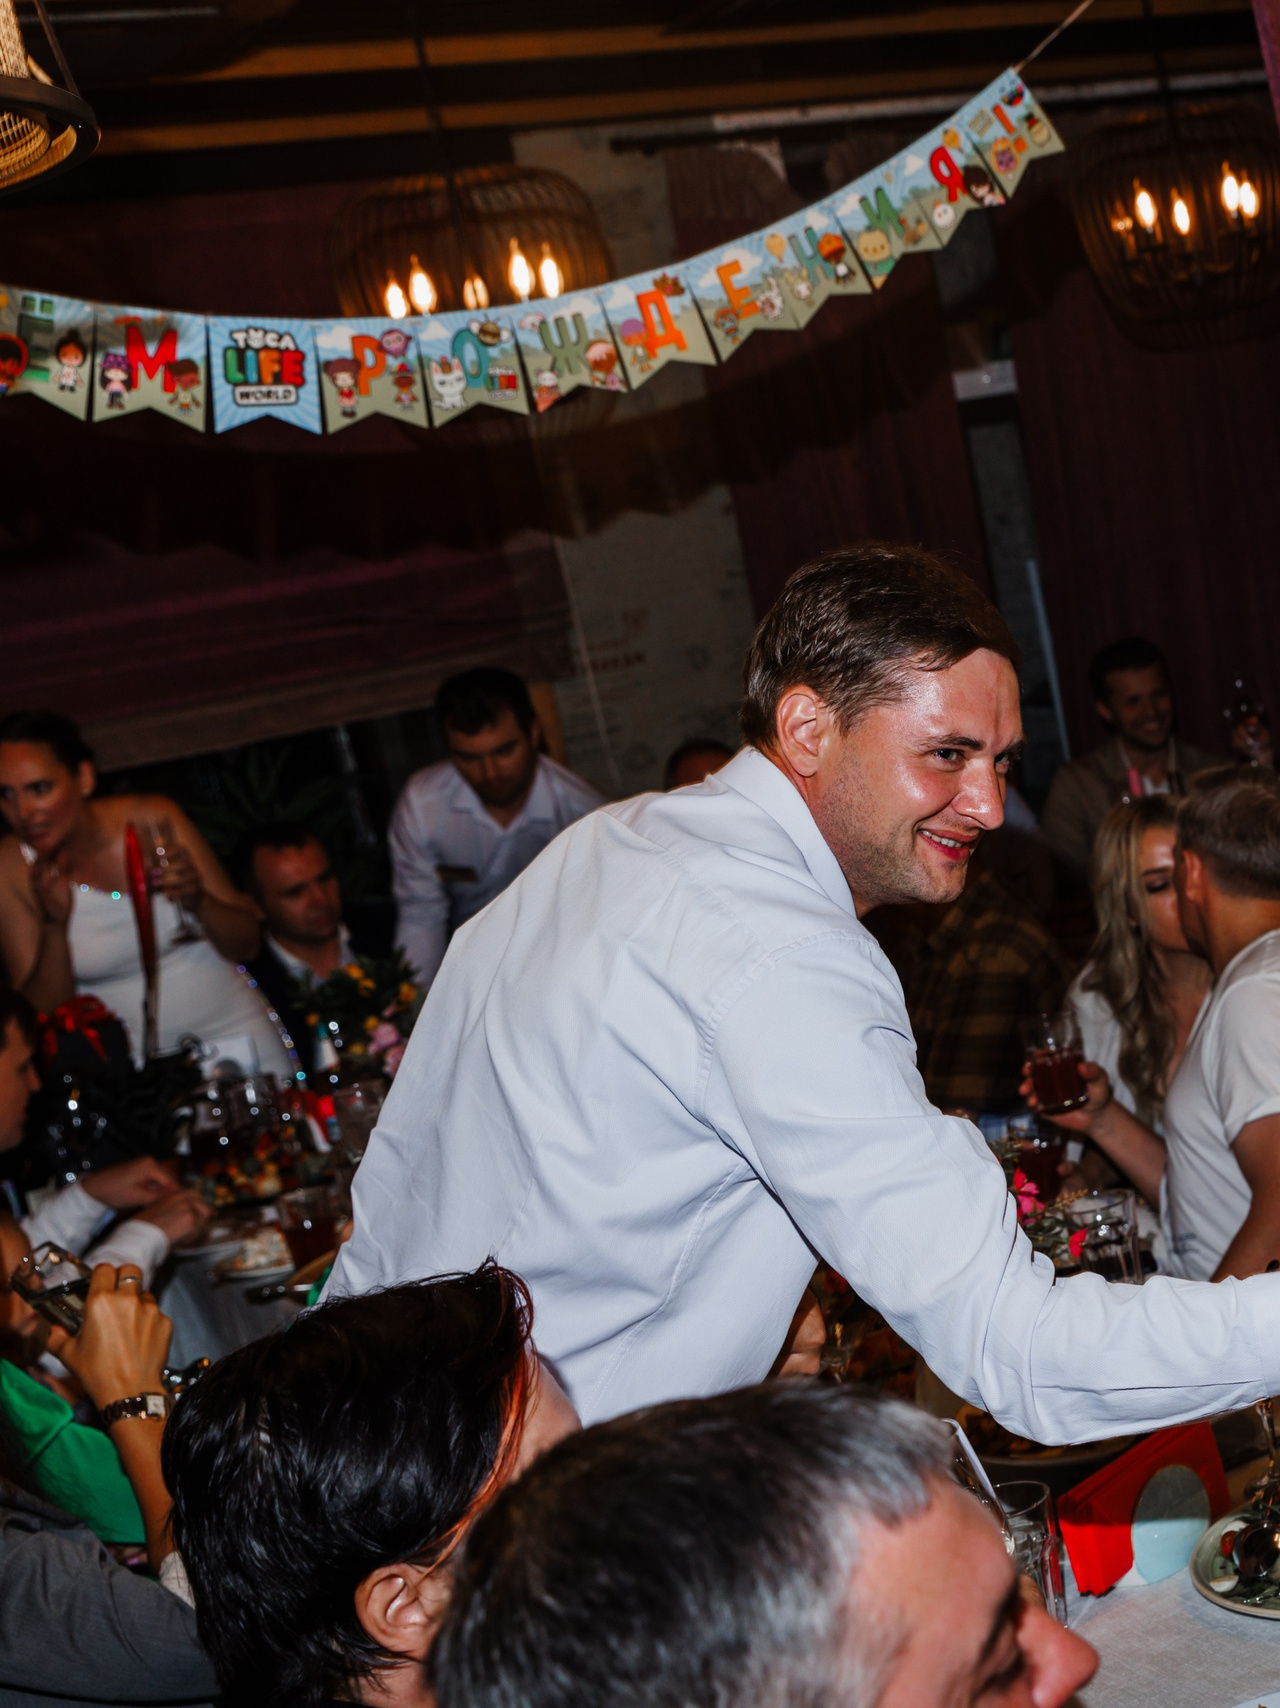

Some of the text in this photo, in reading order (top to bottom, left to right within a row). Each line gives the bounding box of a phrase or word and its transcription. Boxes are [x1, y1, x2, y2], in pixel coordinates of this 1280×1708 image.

[231, 328, 296, 351] TOCA
[225, 348, 305, 387] LIFE
[239, 390, 292, 401] WORLD
